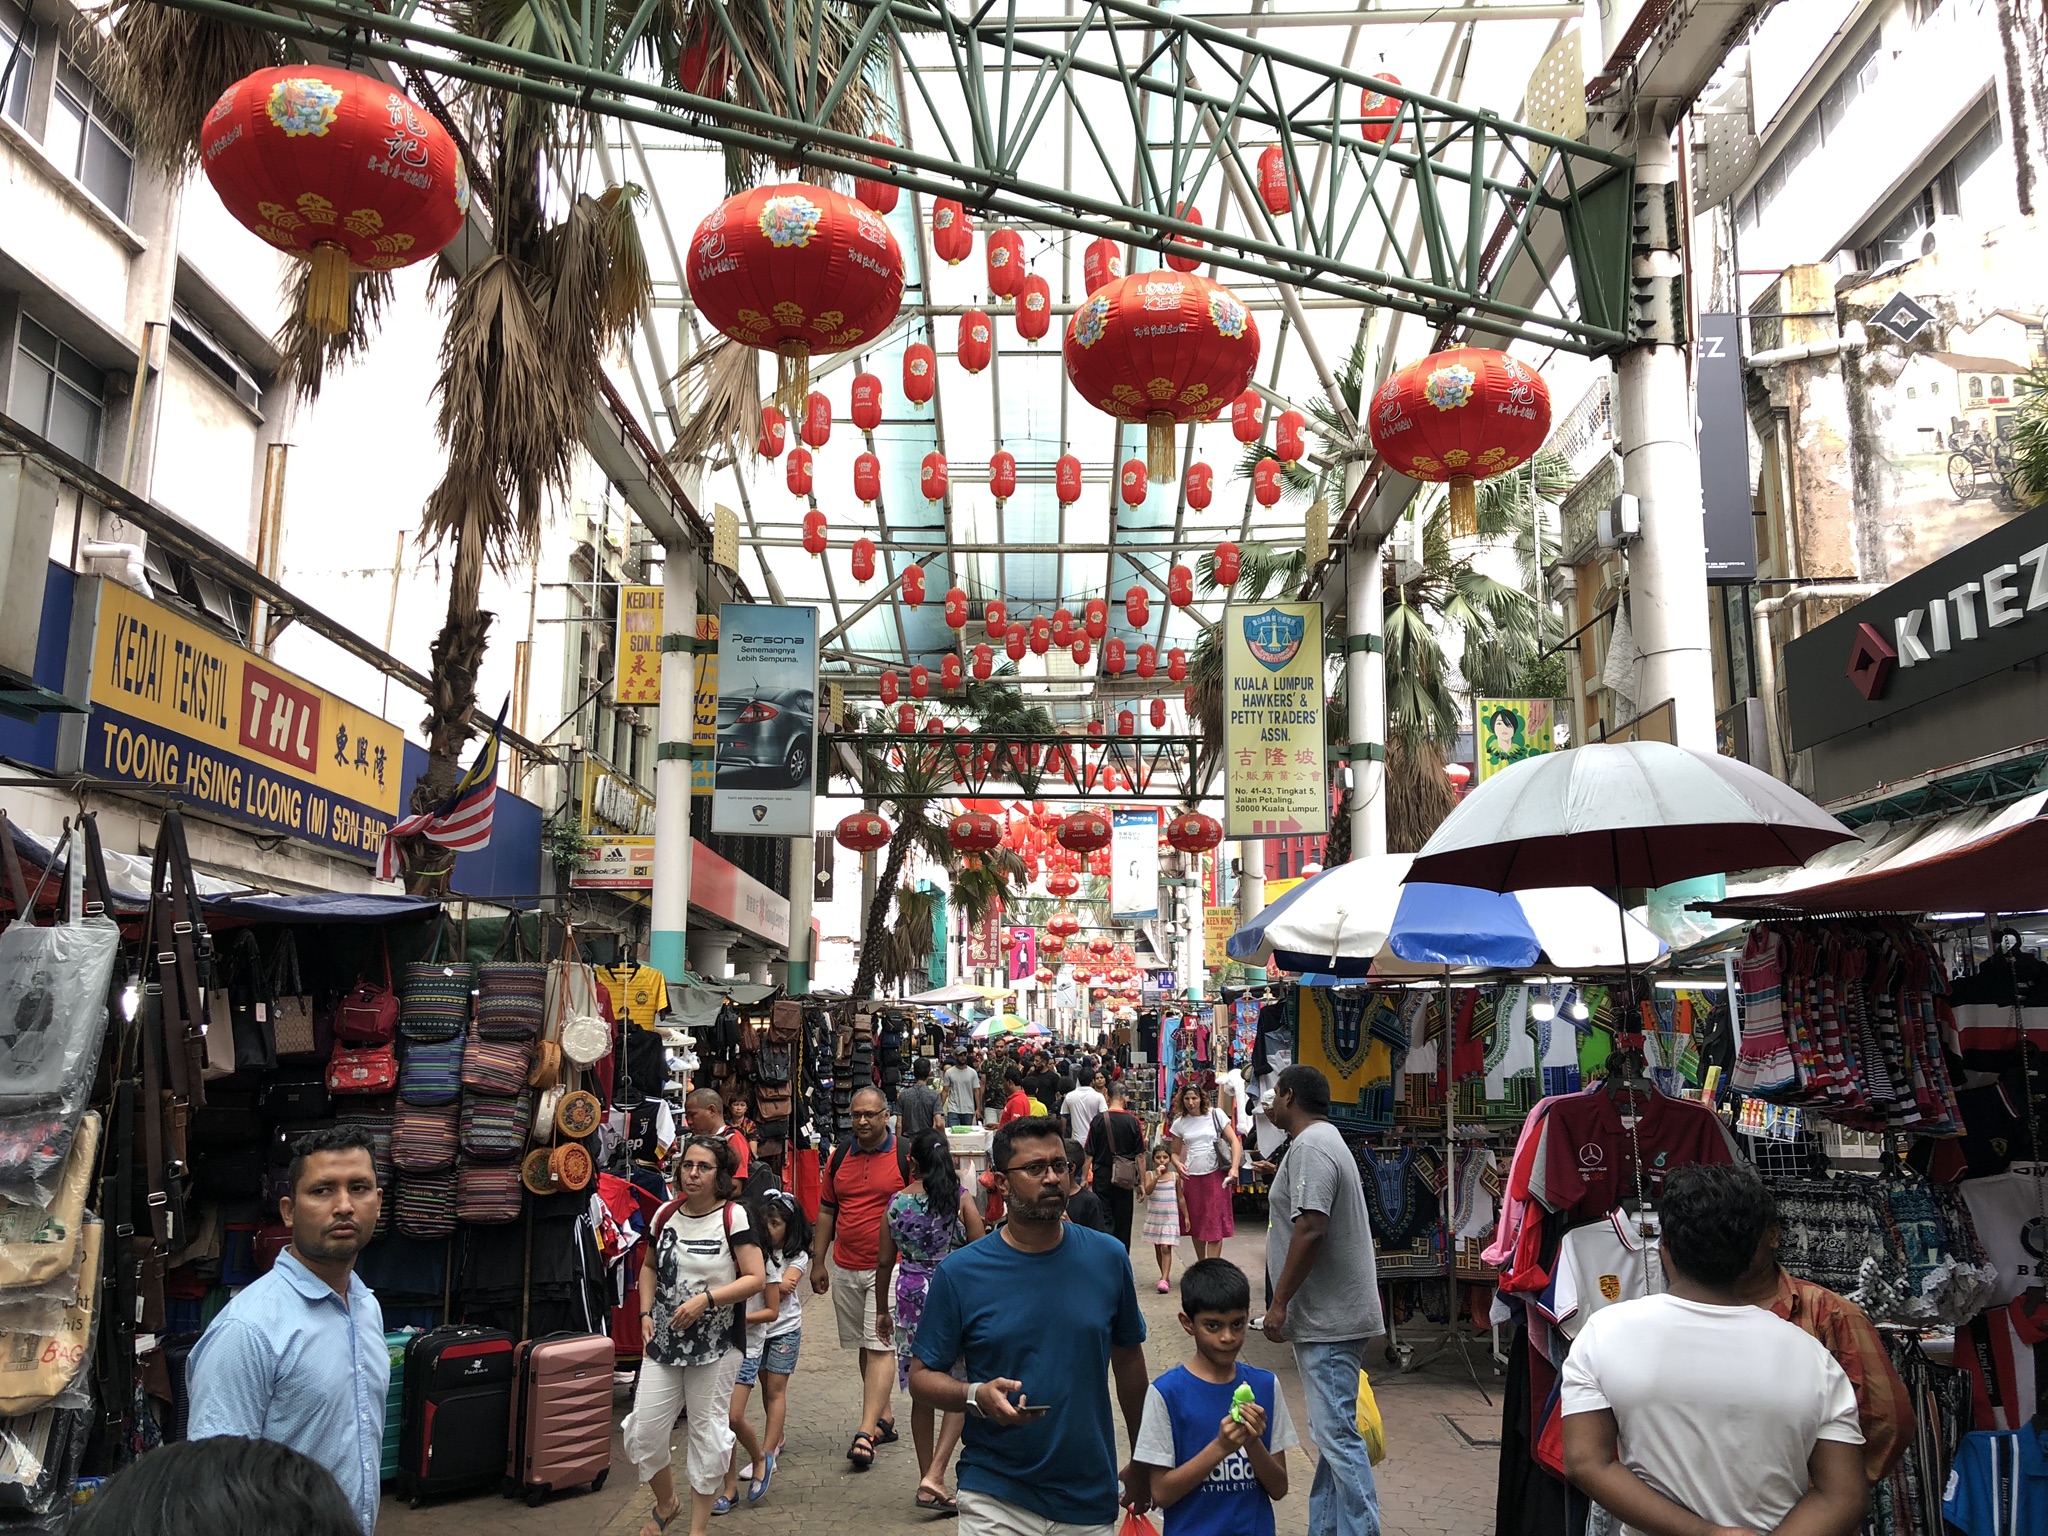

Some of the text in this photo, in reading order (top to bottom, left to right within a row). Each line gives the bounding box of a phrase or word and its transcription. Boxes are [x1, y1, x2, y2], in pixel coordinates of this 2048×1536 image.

[1143, 296, 1181, 310] KEE
[626, 592, 654, 609] KEDAI
[630, 635, 653, 652] SDN.
[732, 634, 804, 645] Persona
[741, 646, 795, 654] Sememangnya
[110, 612, 228, 730] KEDAI TEKSTIL
[1234, 677, 1314, 690] KUALA LUMPUR
[1243, 692, 1307, 707] HAWKERS' &
[250, 681, 311, 760] THL
[1231, 709, 1318, 724] PETTY TRADERS'
[1260, 727, 1291, 741] ASSN.
[335, 722, 388, 786] 東興隆
[1234, 747, 1317, 766] 吉隆坡
[1231, 770, 1322, 781] 小販商業公會
[103, 721, 179, 784] TOONG
[186, 752, 242, 809] HSING
[246, 774, 301, 828] LOONG
[307, 793, 328, 838] (M)
[332, 804, 360, 846] SDN
[1235, 787, 1316, 796] No. 41-43, Tingkat 5,
[1259, 796, 1294, 805] Petaling,
[1287, 805, 1320, 813] Lumpur.
[41, 1341, 85, 1363] BAG
